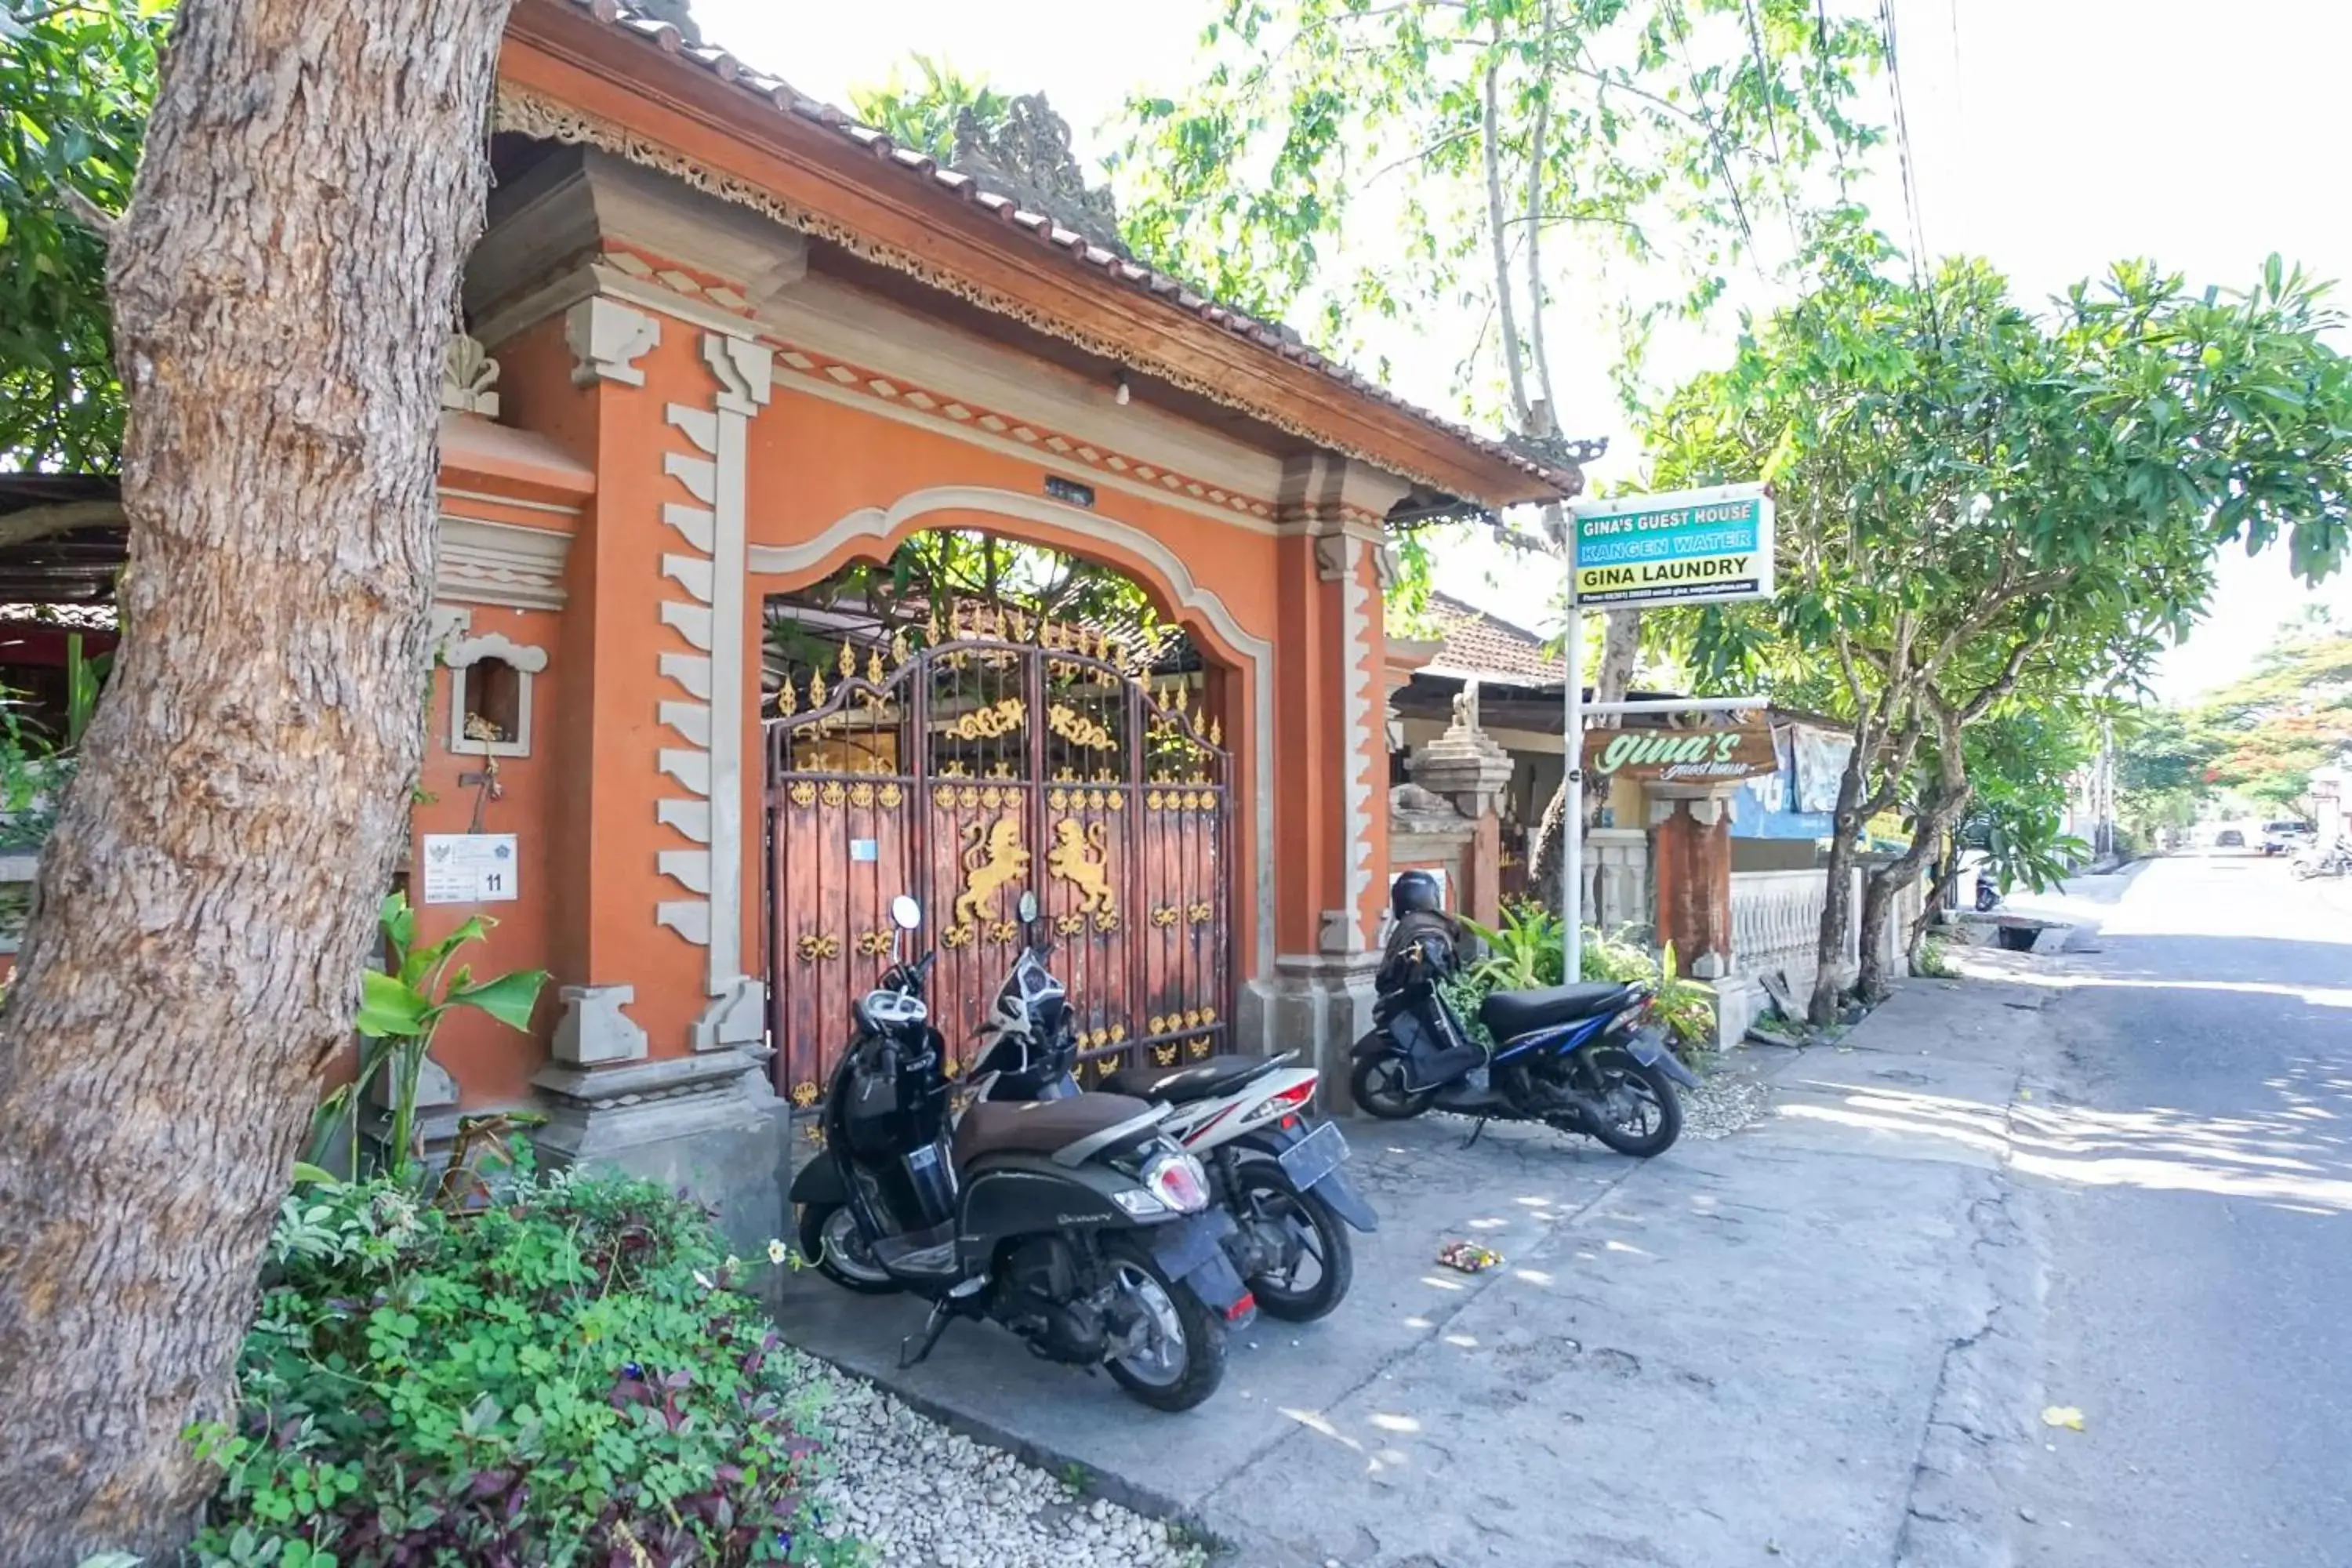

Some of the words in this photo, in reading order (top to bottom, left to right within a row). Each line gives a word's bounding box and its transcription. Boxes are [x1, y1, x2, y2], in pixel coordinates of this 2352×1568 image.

[1583, 521, 1633, 537] GINA'S
[1639, 512, 1690, 529] GUEST
[1695, 504, 1751, 524] HOUSE
[1582, 539, 1668, 562] KANGEN
[1674, 531, 1752, 554] WATER
[1584, 568, 1635, 586] GINA
[1642, 557, 1748, 581] LAUNDRY
[487, 873, 501, 891] 11
